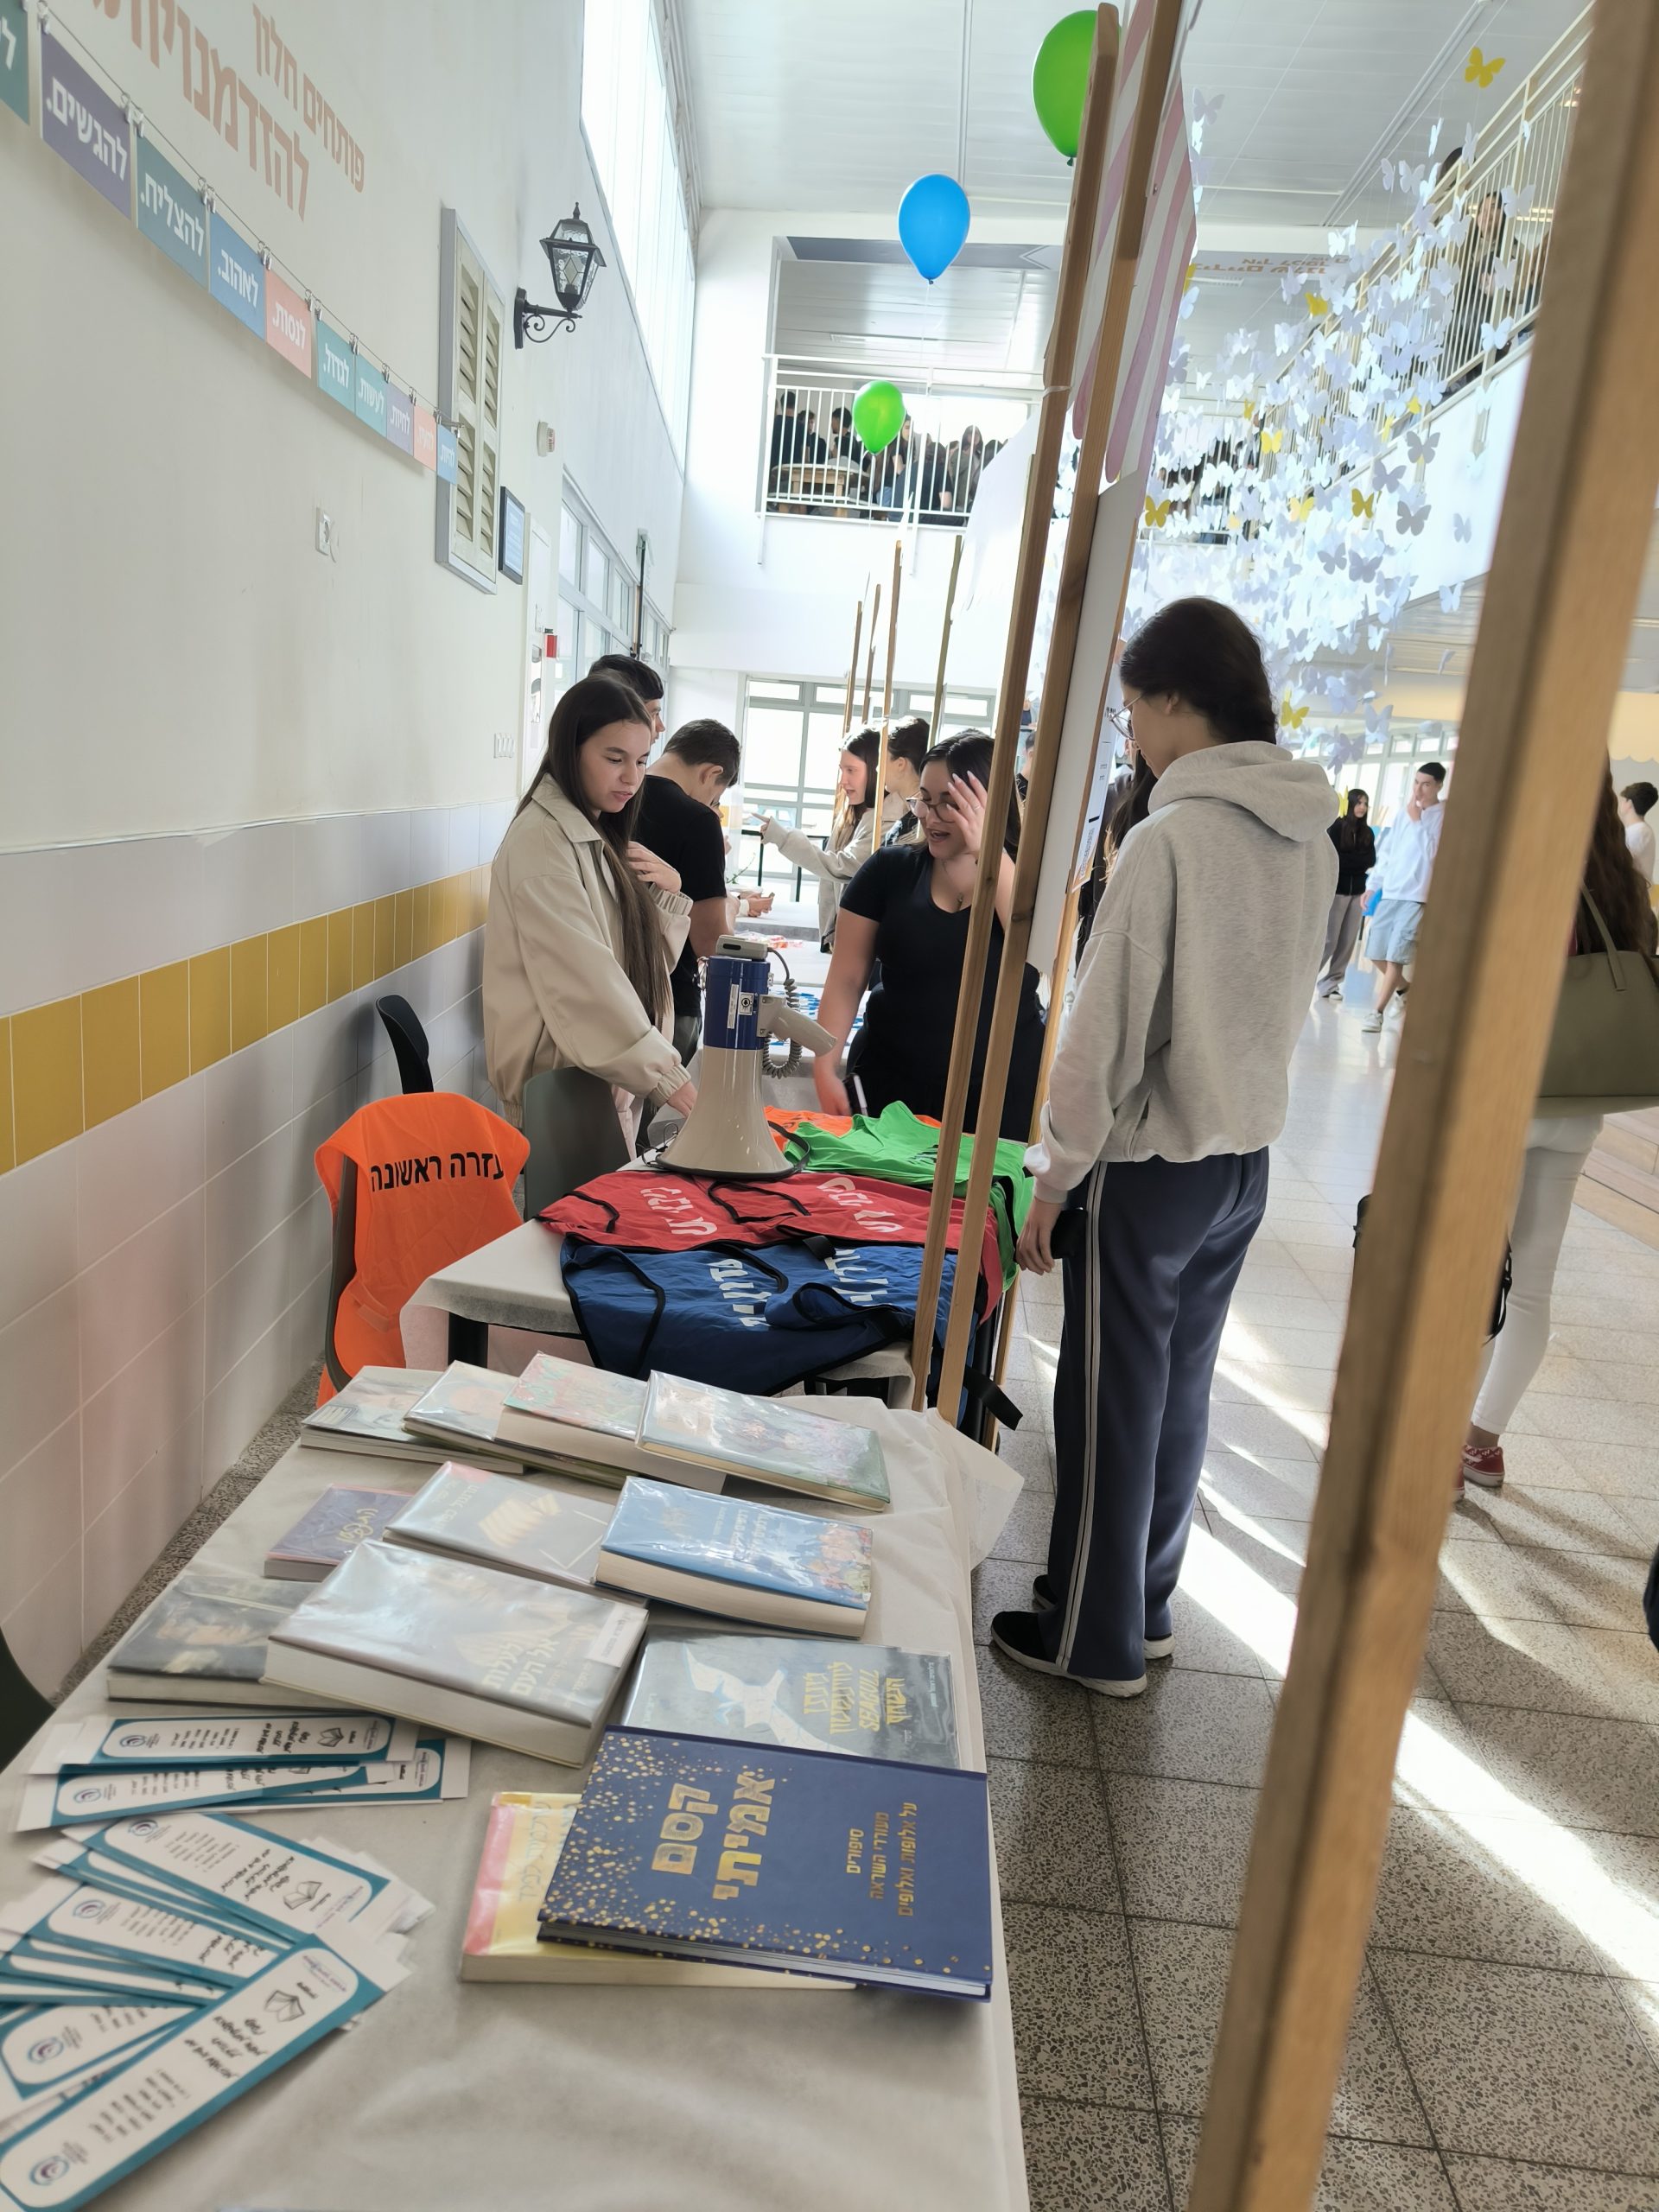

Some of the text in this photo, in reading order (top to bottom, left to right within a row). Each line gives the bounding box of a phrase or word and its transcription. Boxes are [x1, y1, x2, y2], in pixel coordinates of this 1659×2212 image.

[252, 2, 365, 194] פותחים חלון
[46, 76, 128, 181] להגשים.
[140, 172, 205, 257] להצליח.
[217, 248, 258, 308] לאהוב.
[272, 302, 306, 350] לנסות.
[323, 342, 350, 389] לגדול.
[358, 378, 385, 415] לעשות.
[370, 1154, 442, 1192] ראשונה
[482, 1643, 524, 1689] לעלות
[509, 1660, 546, 1696] העם
[526, 1638, 560, 1659] אל
[857, 1669, 880, 1732] SEAGULL
[652, 1783, 720, 1875] קסם
[712, 1774, 776, 1901] אמיתי
[847, 1827, 864, 1874] סיפורים
[870, 1811, 889, 1900] מעוררי השראה
[894, 1802, 918, 1916] על אלופות ואלופים
